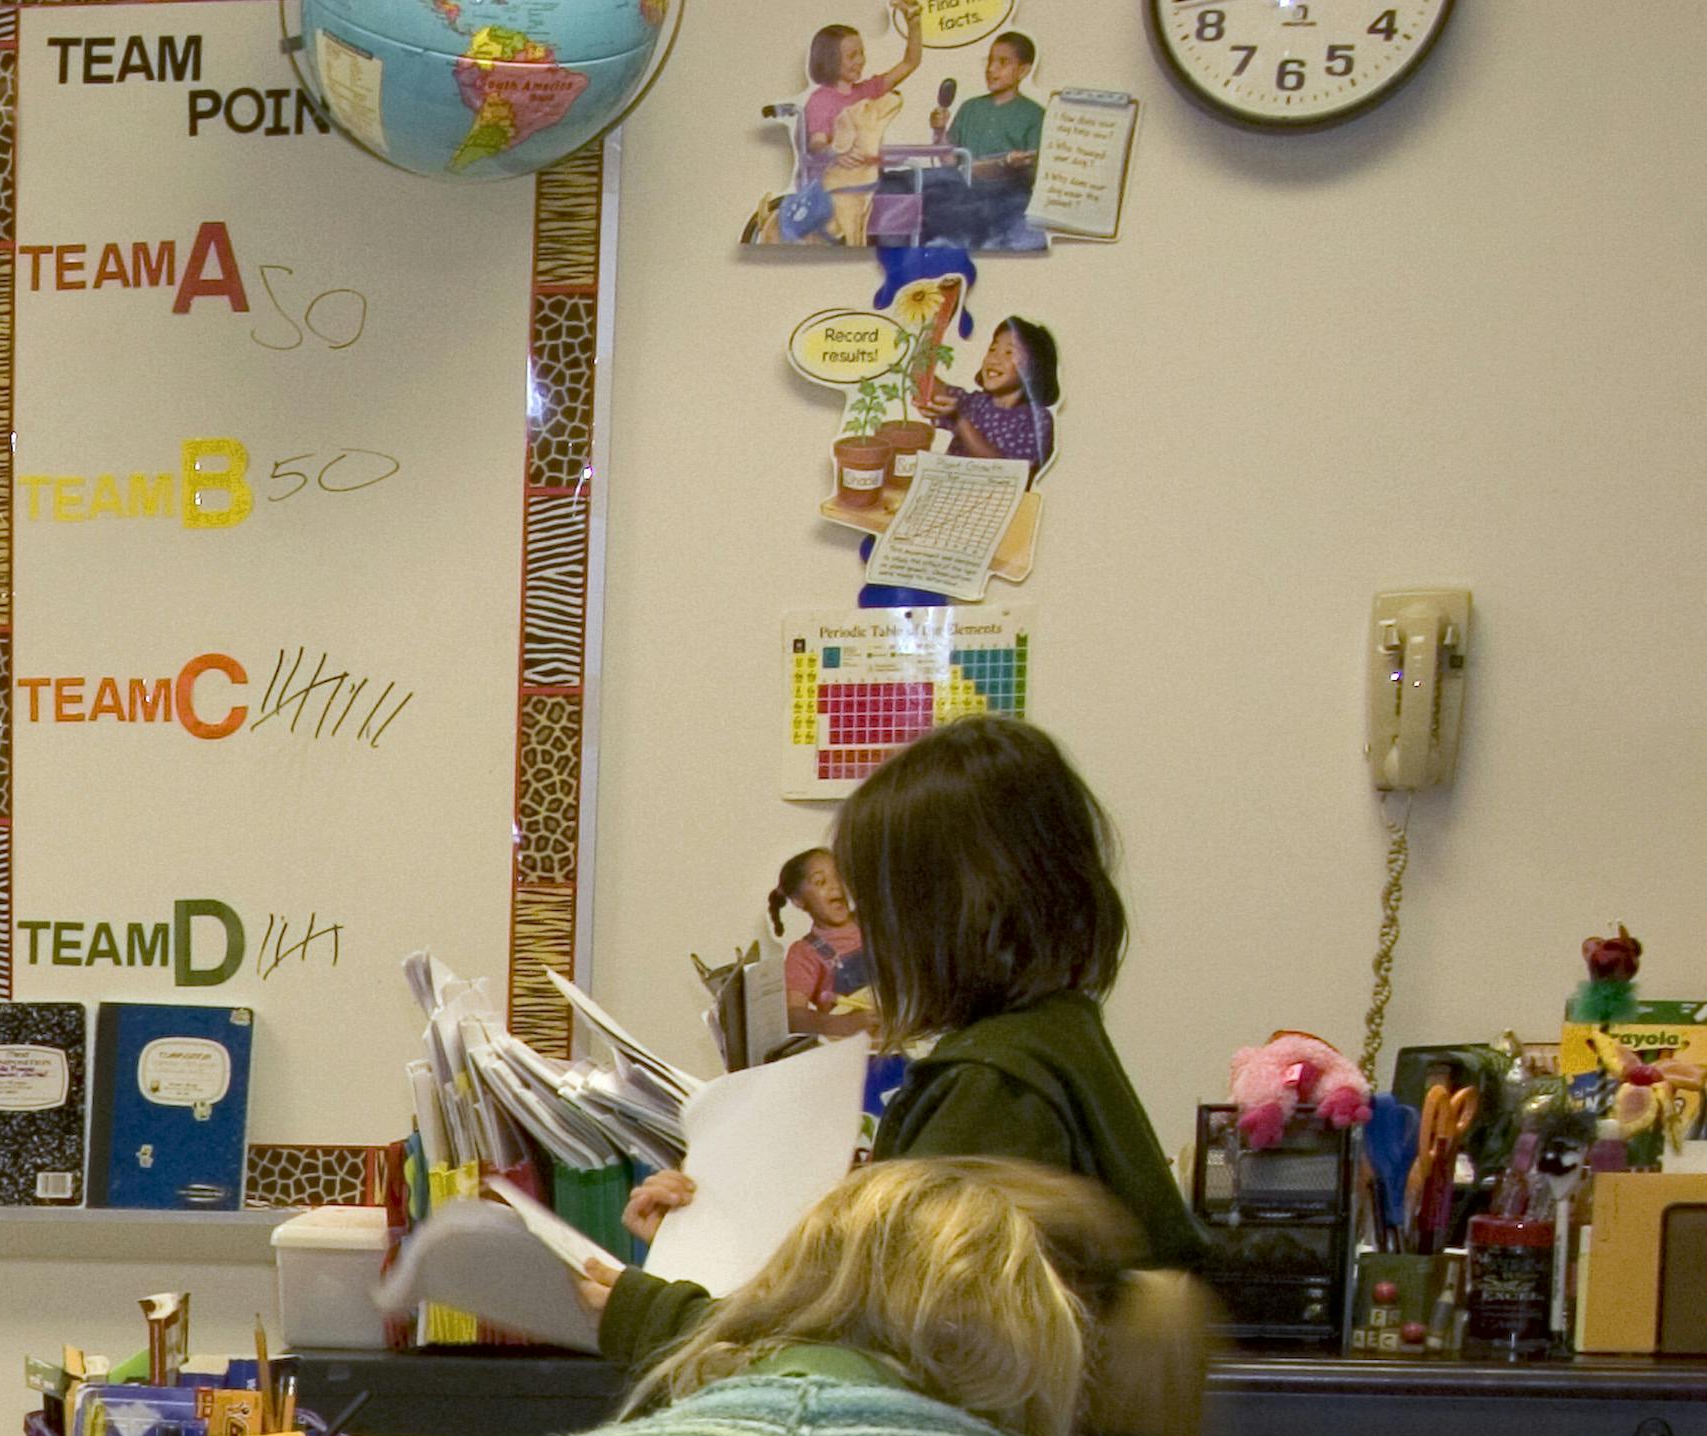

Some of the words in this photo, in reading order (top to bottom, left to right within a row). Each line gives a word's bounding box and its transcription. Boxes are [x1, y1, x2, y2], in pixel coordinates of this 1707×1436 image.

[1195, 10, 1226, 42] 8
[1366, 9, 1398, 42] 4
[48, 35, 203, 85] TEAM
[1229, 45, 1258, 77] 7
[1276, 59, 1306, 92] 6
[1324, 45, 1355, 77] 5
[522, 80, 574, 92] America
[19, 240, 175, 292] TEAM
[172, 221, 250, 315] A
[824, 328, 879, 343] Record
[822, 348, 879, 363] results!
[18, 471, 174, 523] TEAM
[182, 436, 254, 531] B
[268, 448, 401, 502] 50
[819, 626, 867, 638] Periodic
[17, 677, 173, 724] TEAM
[176, 652, 250, 741] C
[17, 920, 172, 968] TEAM
[173, 899, 247, 987] D
